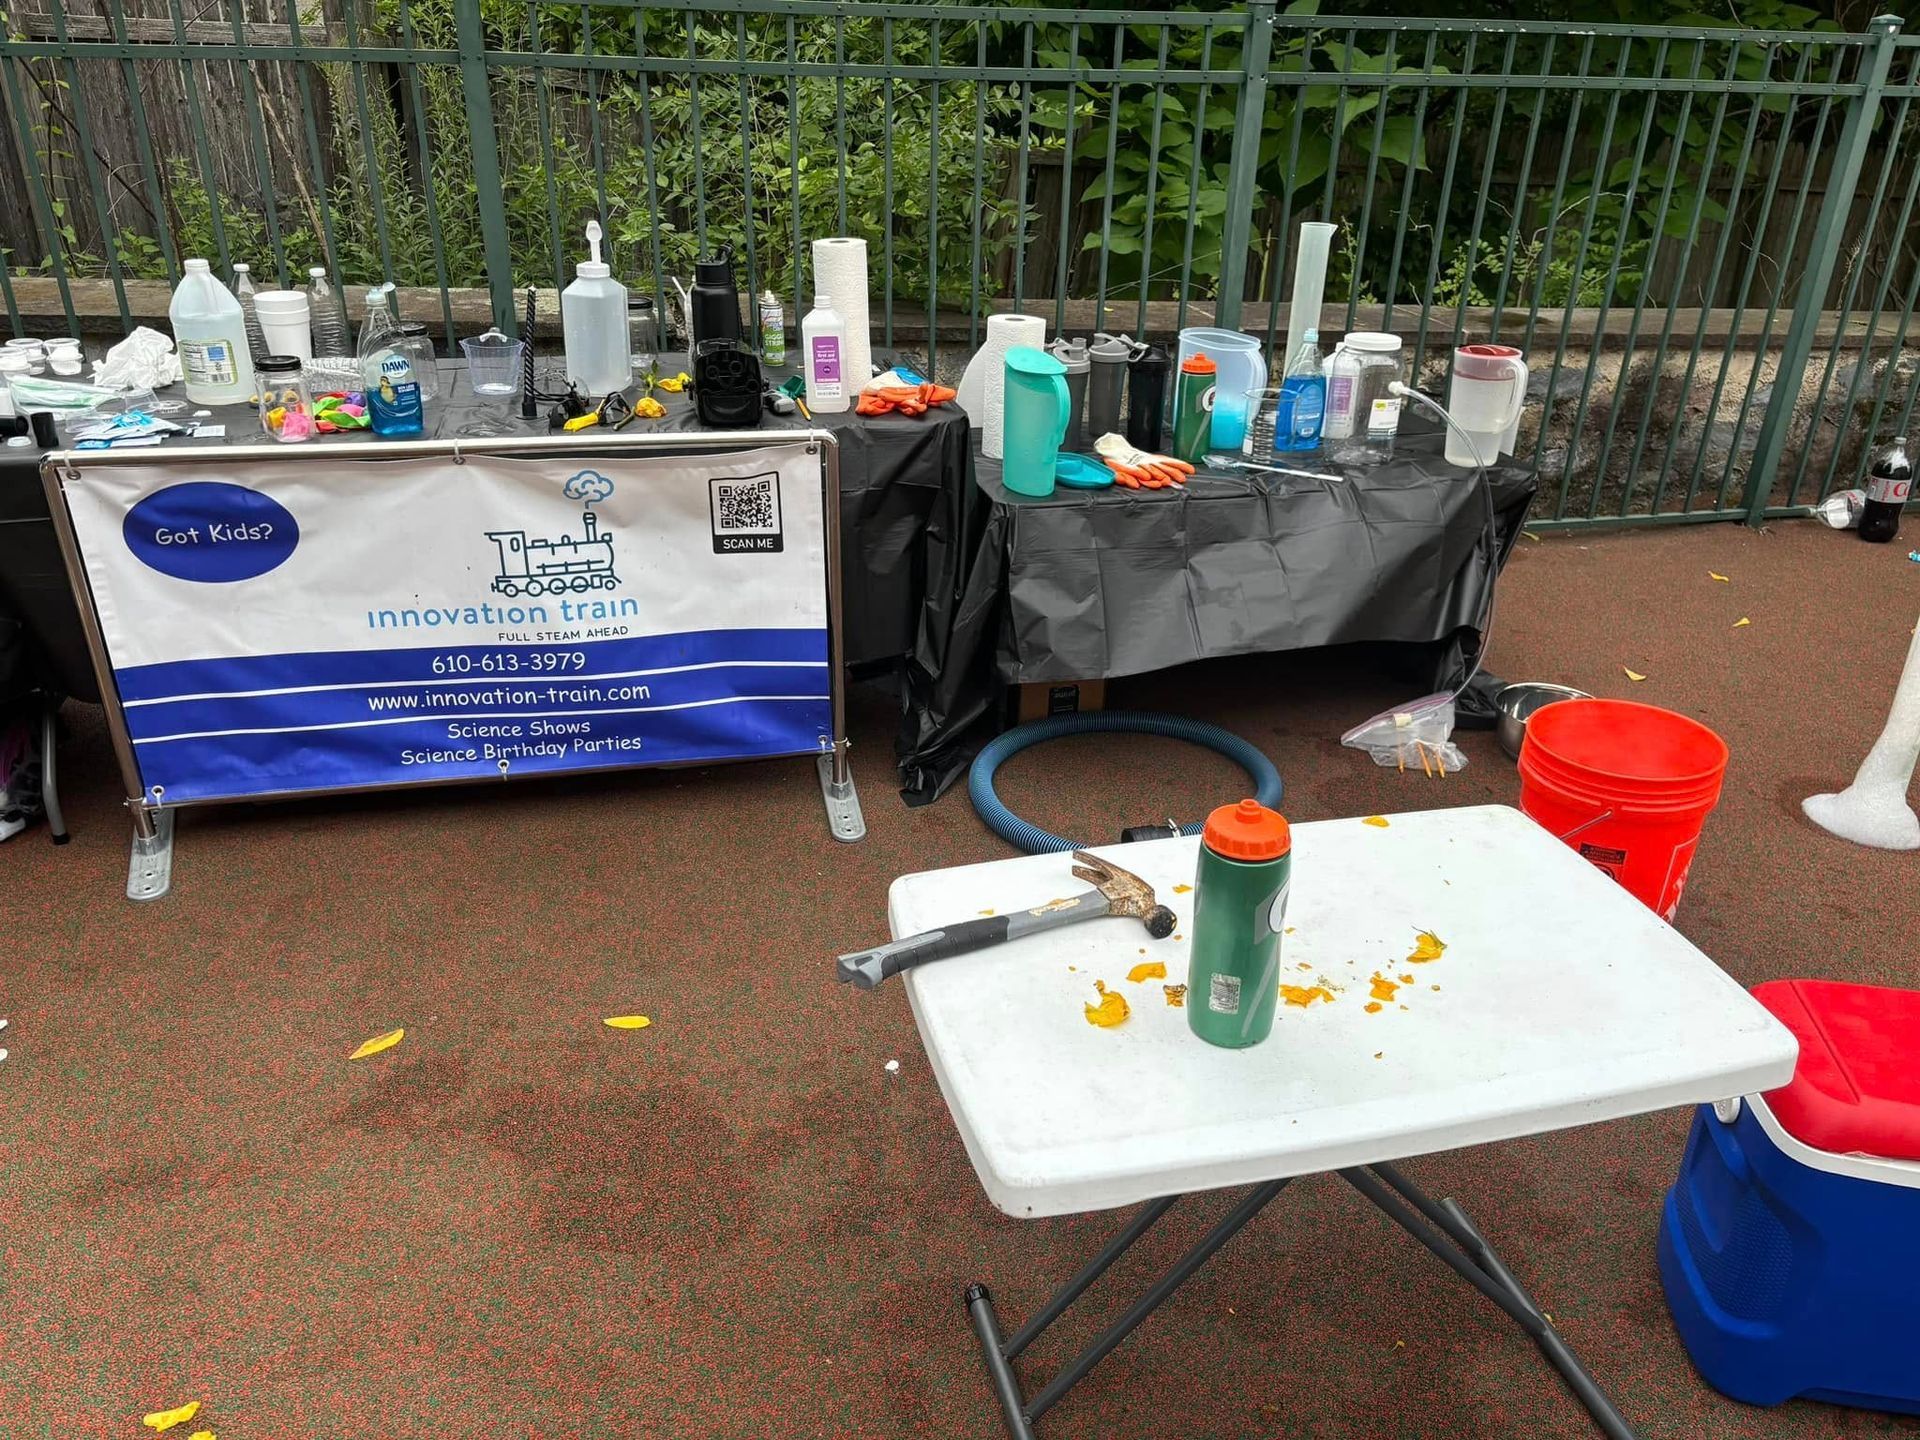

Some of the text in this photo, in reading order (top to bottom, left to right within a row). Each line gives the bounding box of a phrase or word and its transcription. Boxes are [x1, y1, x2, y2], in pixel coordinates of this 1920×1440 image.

[381, 359, 410, 373] DAWN
[155, 522, 273, 545] Got Kids?
[723, 538, 774, 549] SCAN ME
[368, 598, 639, 628] innovation train
[498, 625, 628, 642] FULL STEAM AHEAD
[432, 652, 586, 674] 610-613-3979
[368, 685, 650, 711] www.innovation-train.com
[447, 719, 591, 739] Science Shows
[400, 735, 642, 765] Science Birthday Parties
